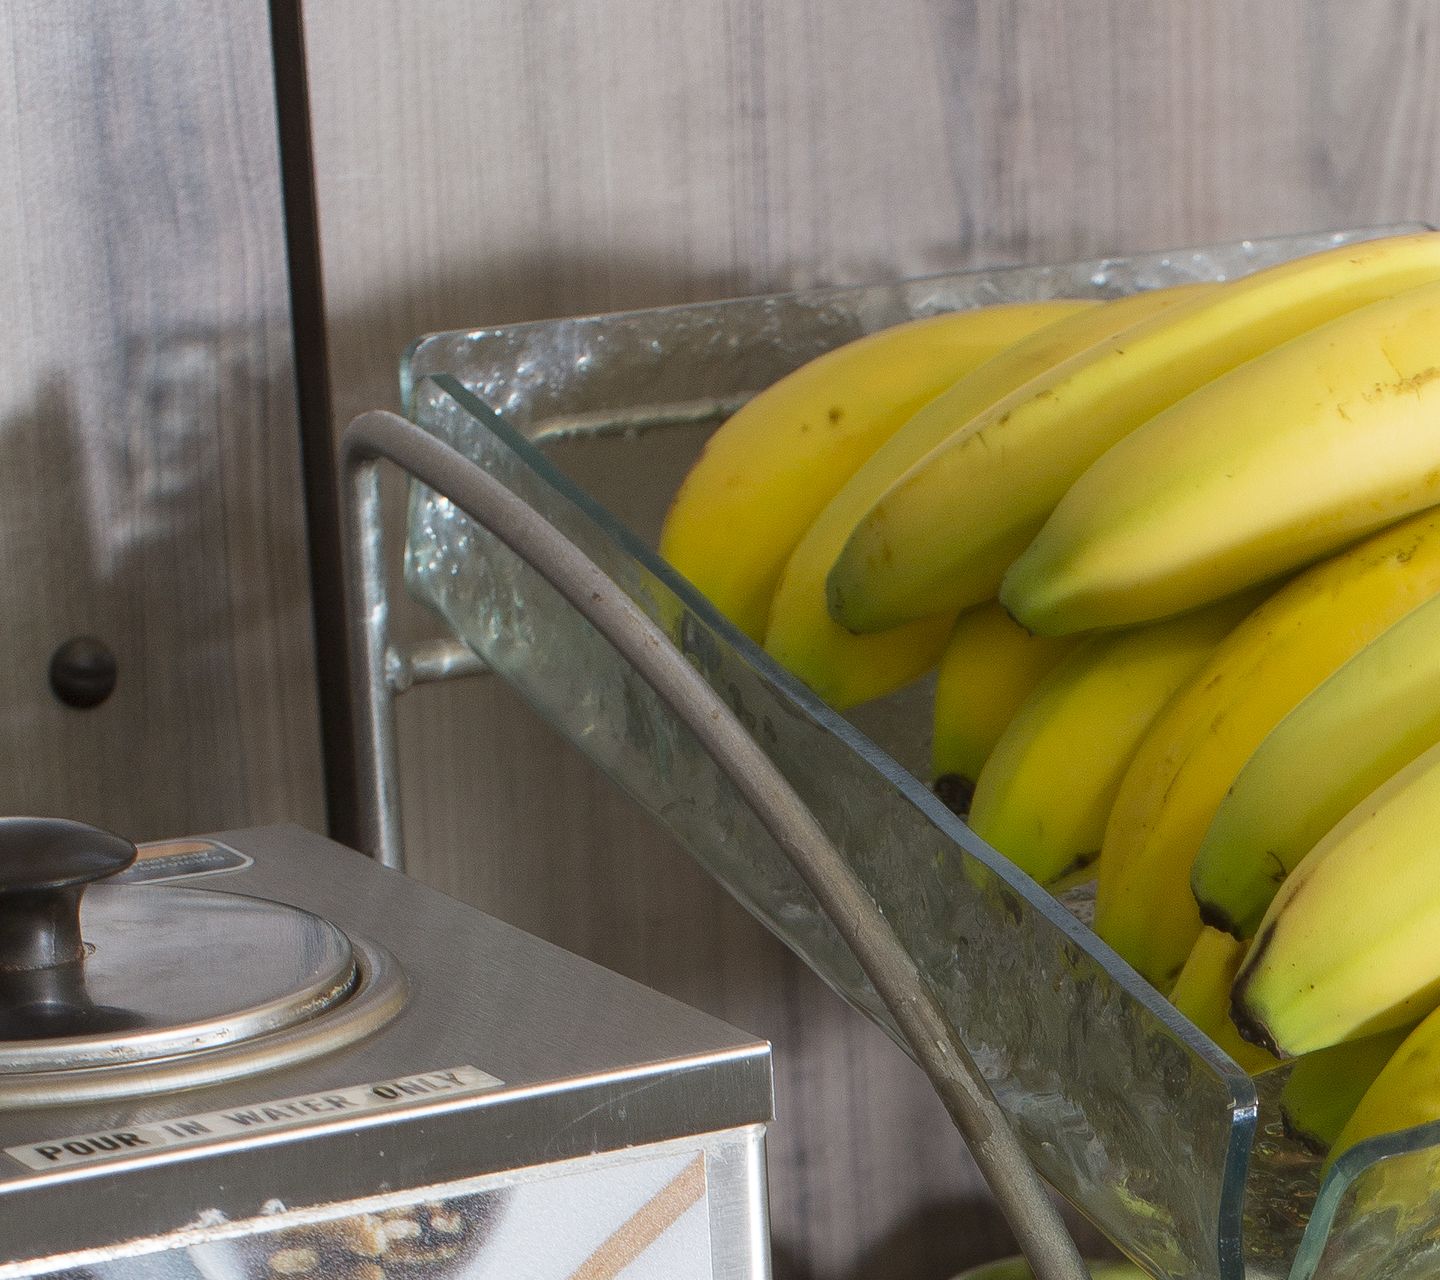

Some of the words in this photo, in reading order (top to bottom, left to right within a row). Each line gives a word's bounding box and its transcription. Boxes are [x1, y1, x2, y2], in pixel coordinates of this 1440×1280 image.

[34, 1132, 151, 1161] POUR
[162, 1120, 213, 1138] IN
[222, 1094, 359, 1127] WATER
[371, 1071, 466, 1100] ONLY
